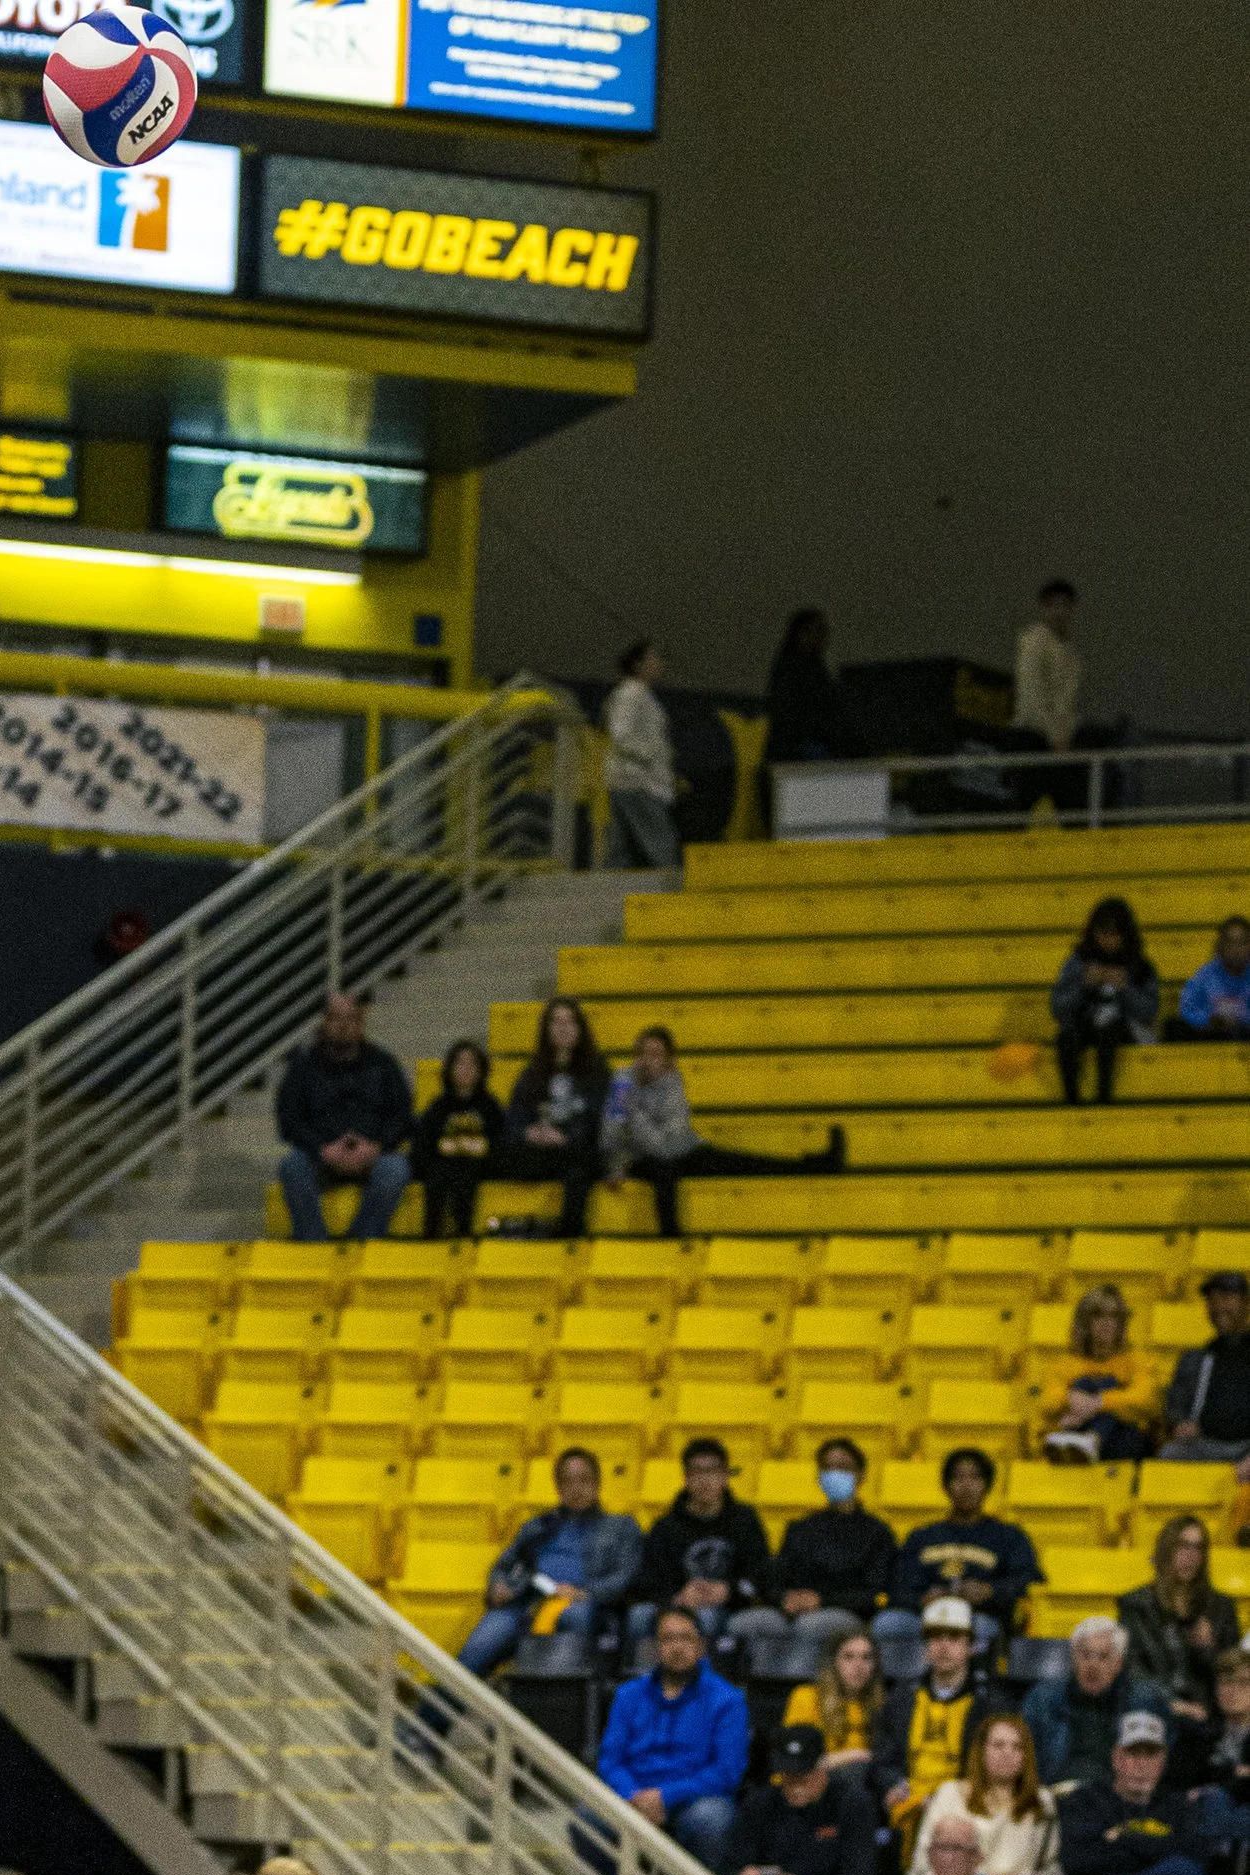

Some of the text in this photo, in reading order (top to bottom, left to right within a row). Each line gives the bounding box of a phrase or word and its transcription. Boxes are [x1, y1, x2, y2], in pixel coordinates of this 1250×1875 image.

[109, 75, 152, 121] molten
[127, 95, 175, 145] NCAA
[273, 199, 640, 293] #GOBEACH
